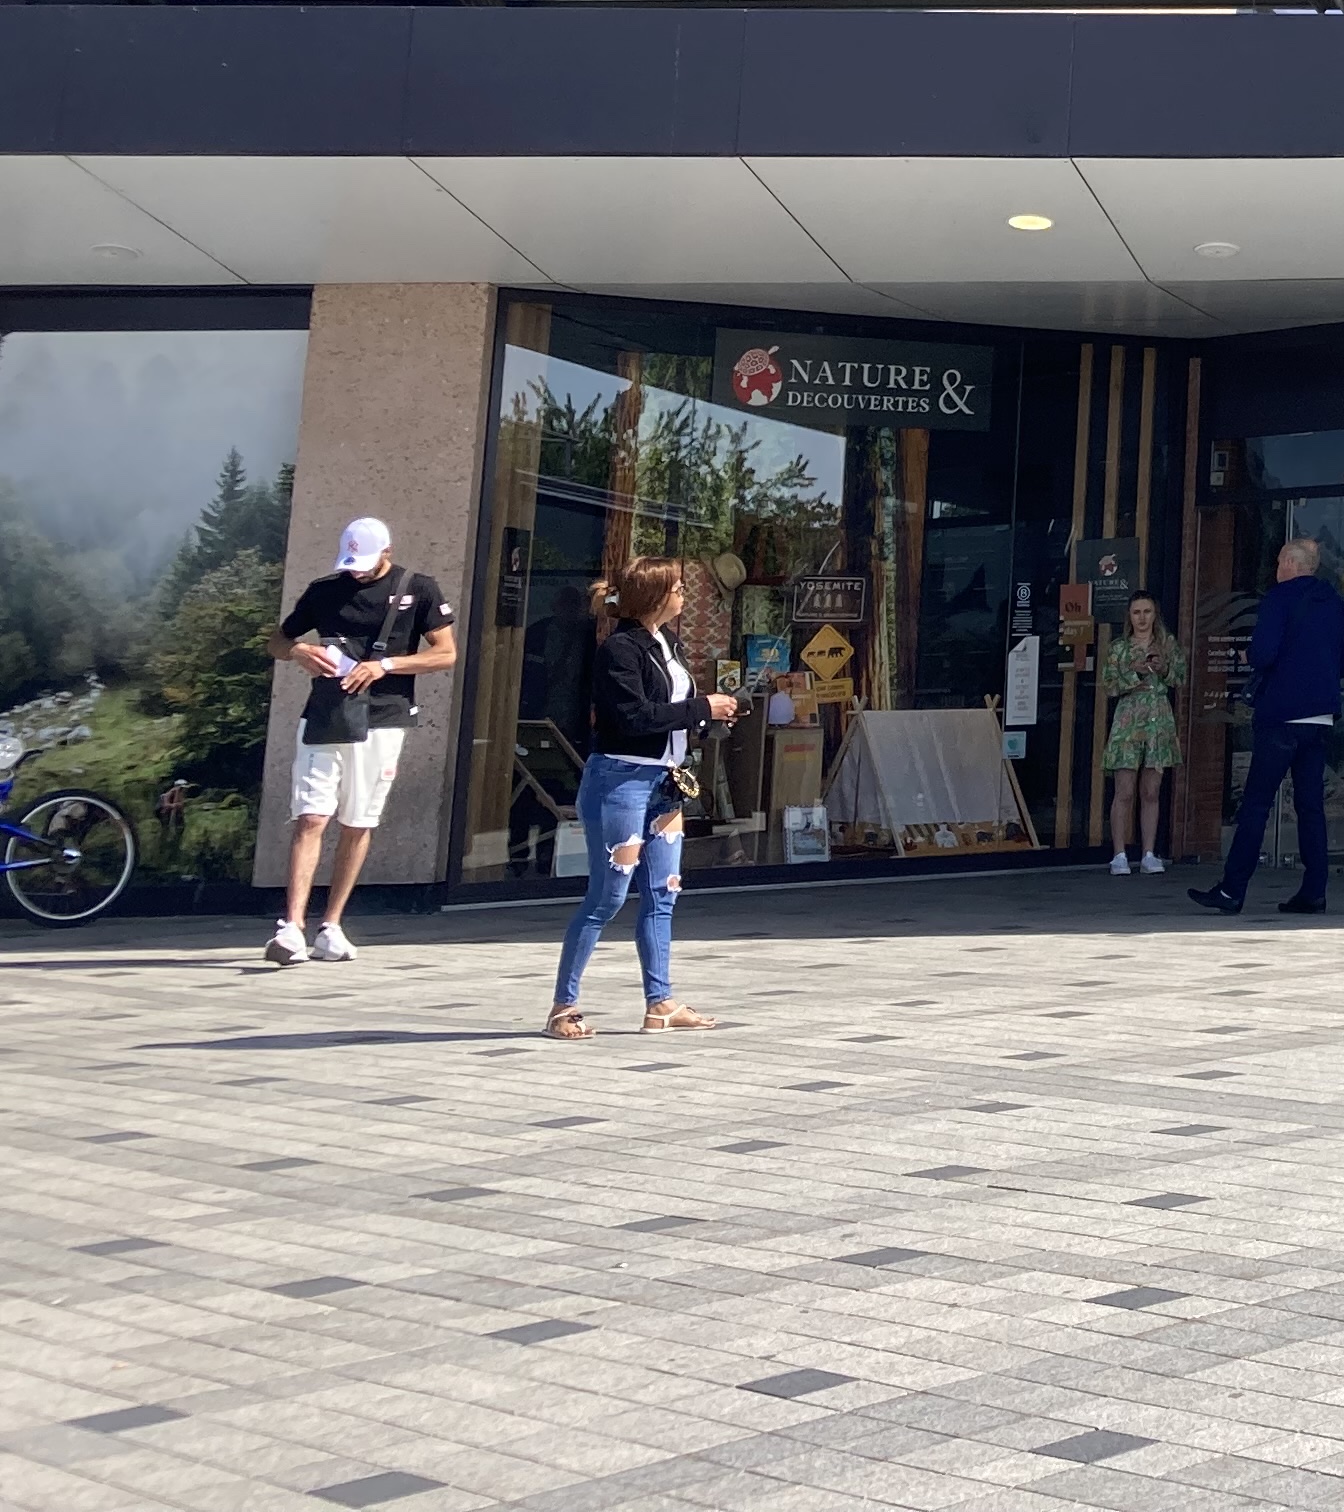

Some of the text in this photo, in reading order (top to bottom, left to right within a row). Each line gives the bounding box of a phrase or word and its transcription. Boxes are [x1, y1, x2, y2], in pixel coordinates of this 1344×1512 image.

[788, 358, 976, 415] NATURE &
[785, 390, 930, 414] DECOUVERTES
[799, 580, 863, 591] YOSEMITE
